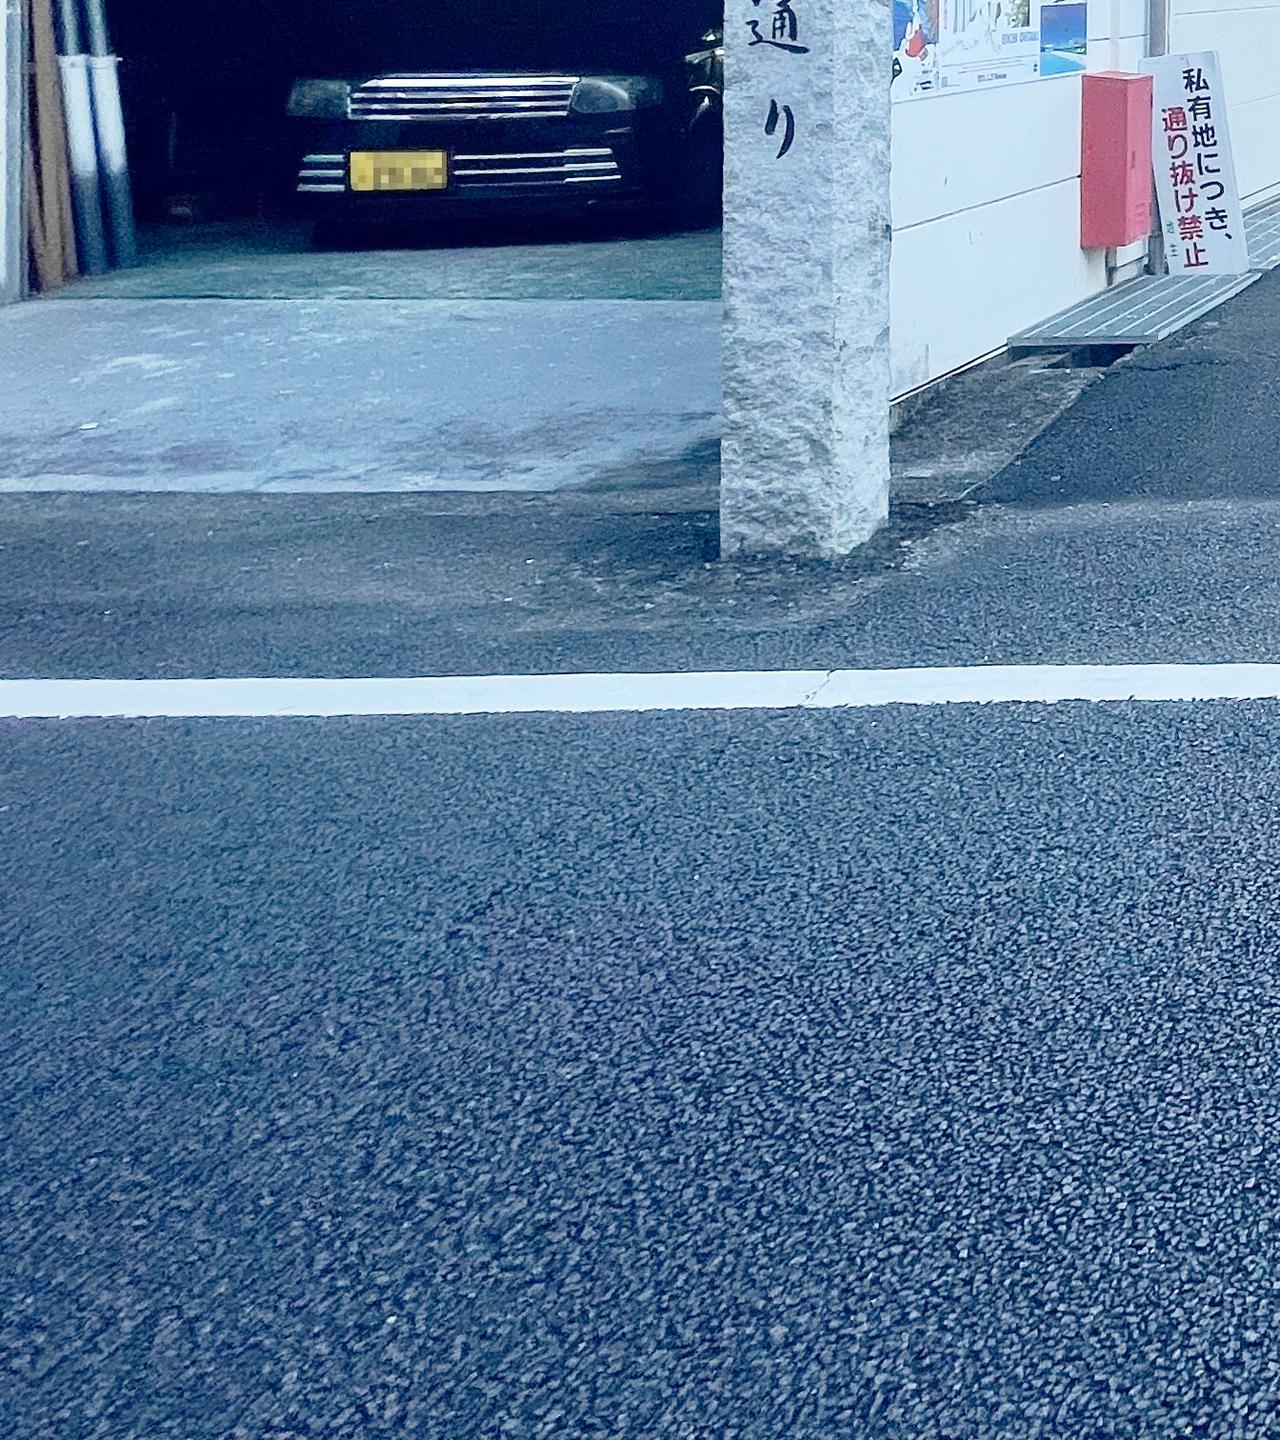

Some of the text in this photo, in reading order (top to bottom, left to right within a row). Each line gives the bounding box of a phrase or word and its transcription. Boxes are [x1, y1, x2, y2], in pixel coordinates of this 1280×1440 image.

[1161, 106, 1209, 268] 通り抜け禁止
[1182, 67, 1233, 240] 私有地につき、
